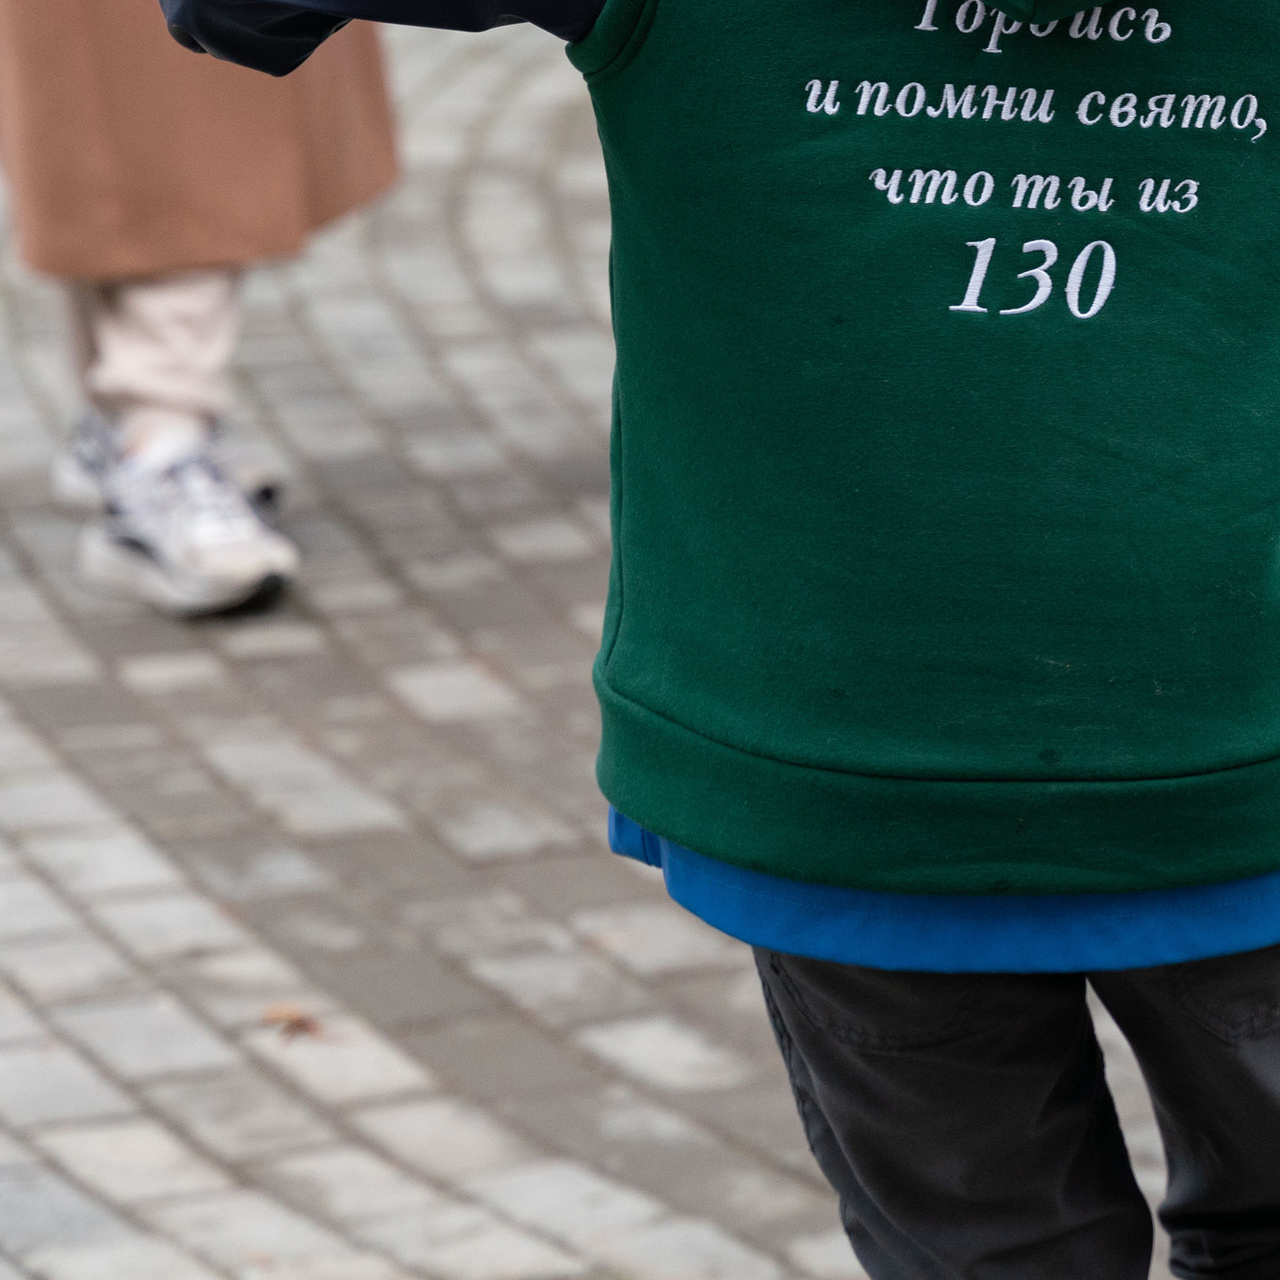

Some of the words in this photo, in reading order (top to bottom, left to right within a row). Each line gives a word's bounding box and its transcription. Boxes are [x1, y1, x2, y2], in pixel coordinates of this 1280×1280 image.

[804, 79, 841, 116] и
[854, 80, 1055, 124] помни
[1075, 90, 1268, 144] свято,
[868, 168, 996, 207] что
[1010, 173, 1116, 212] ты
[1138, 177, 1200, 214] из
[948, 237, 1117, 320] 130
